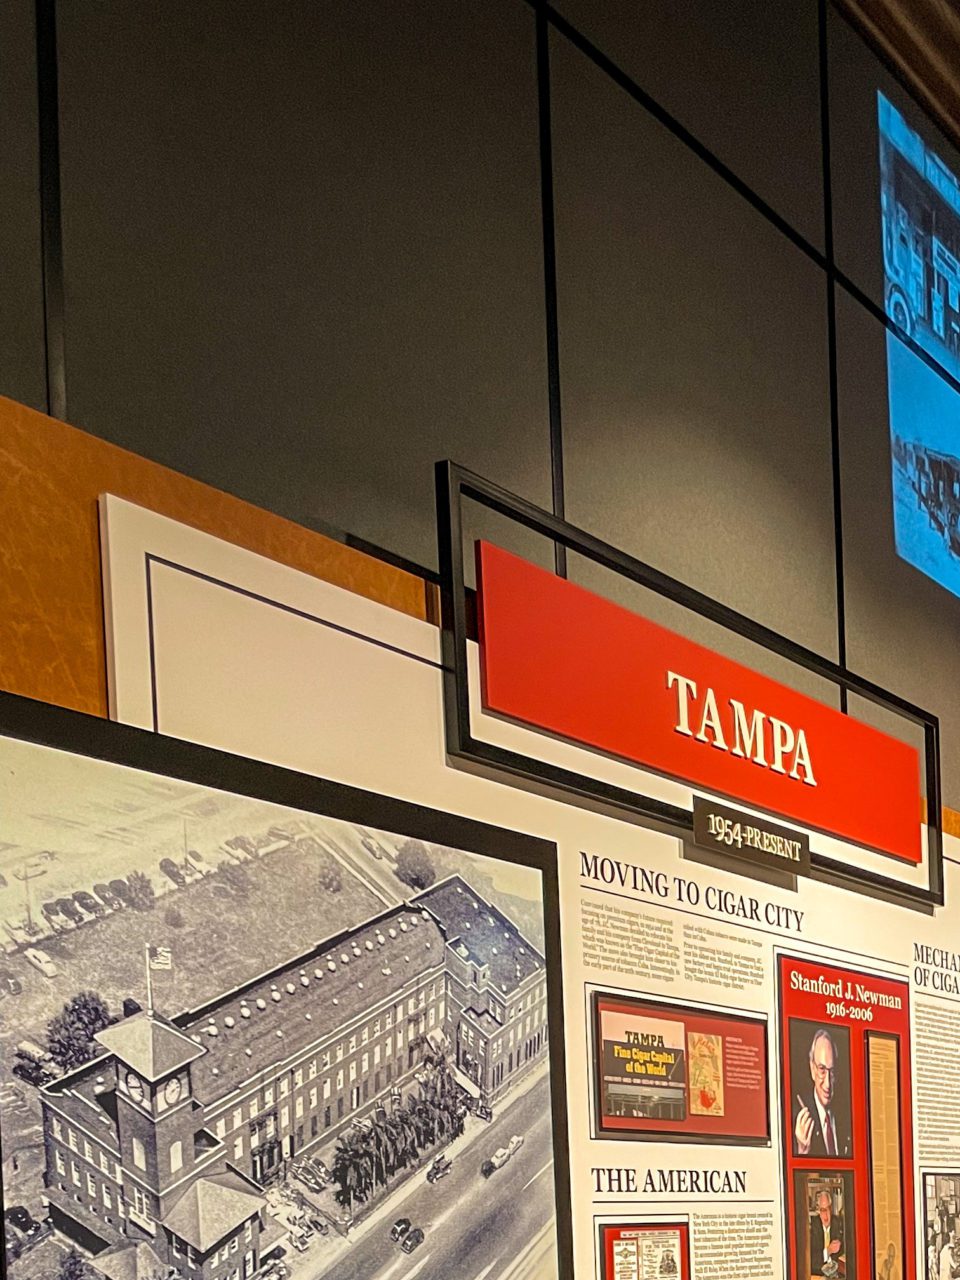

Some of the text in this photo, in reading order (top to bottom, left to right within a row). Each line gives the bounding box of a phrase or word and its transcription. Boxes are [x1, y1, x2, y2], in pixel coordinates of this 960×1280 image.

[667, 671, 817, 786] TAMPA
[707, 814, 801, 862] 1954-PRESENT
[579, 851, 804, 932] MOVING TO CIGAR CITY
[914, 966, 930, 988] OF
[790, 970, 902, 1010] Stanford J. Newman
[826, 1002, 873, 1022] 1916-2006
[625, 1031, 665, 1047] TAMPA
[614, 1045, 675, 1064] Fine Cigar Capital
[625, 1061, 667, 1076] of the World
[591, 1168, 747, 1194] THE AMERICAN
